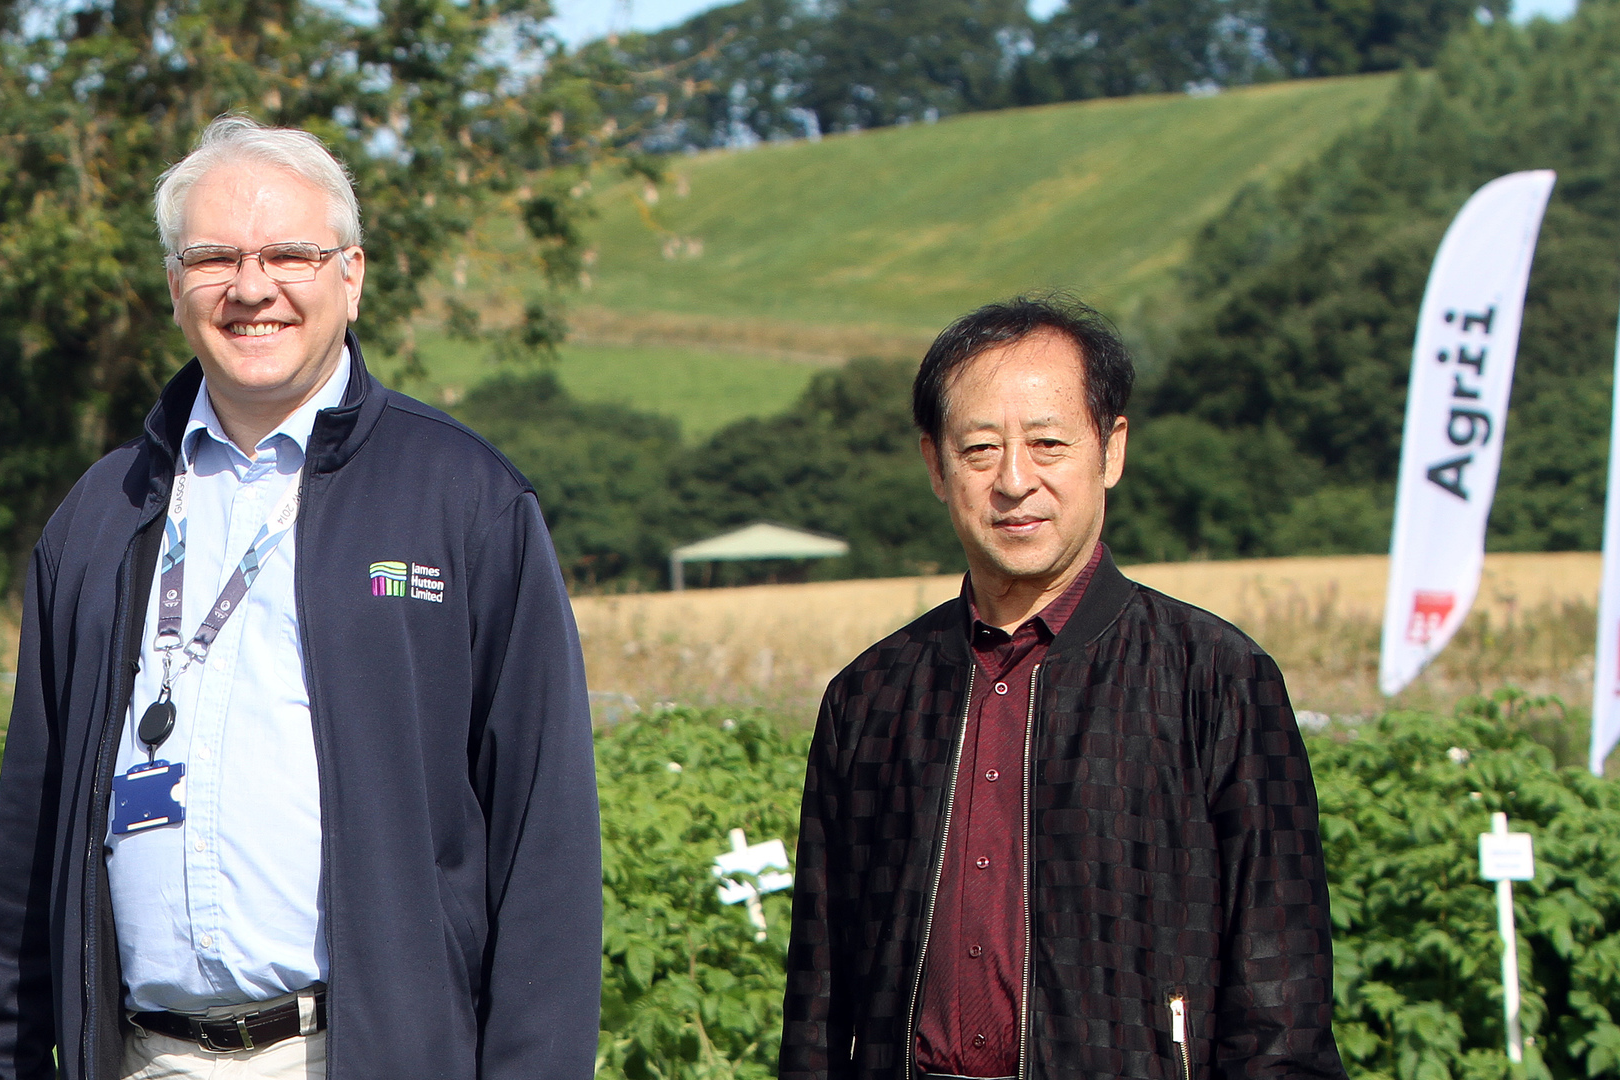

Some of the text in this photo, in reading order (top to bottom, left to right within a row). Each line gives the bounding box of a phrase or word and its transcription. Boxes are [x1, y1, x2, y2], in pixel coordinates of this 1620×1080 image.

[1426, 304, 1496, 502] Agrii
[411, 562, 441, 577] James
[411, 575, 445, 591] Hutton
[410, 587, 444, 604] Limited
